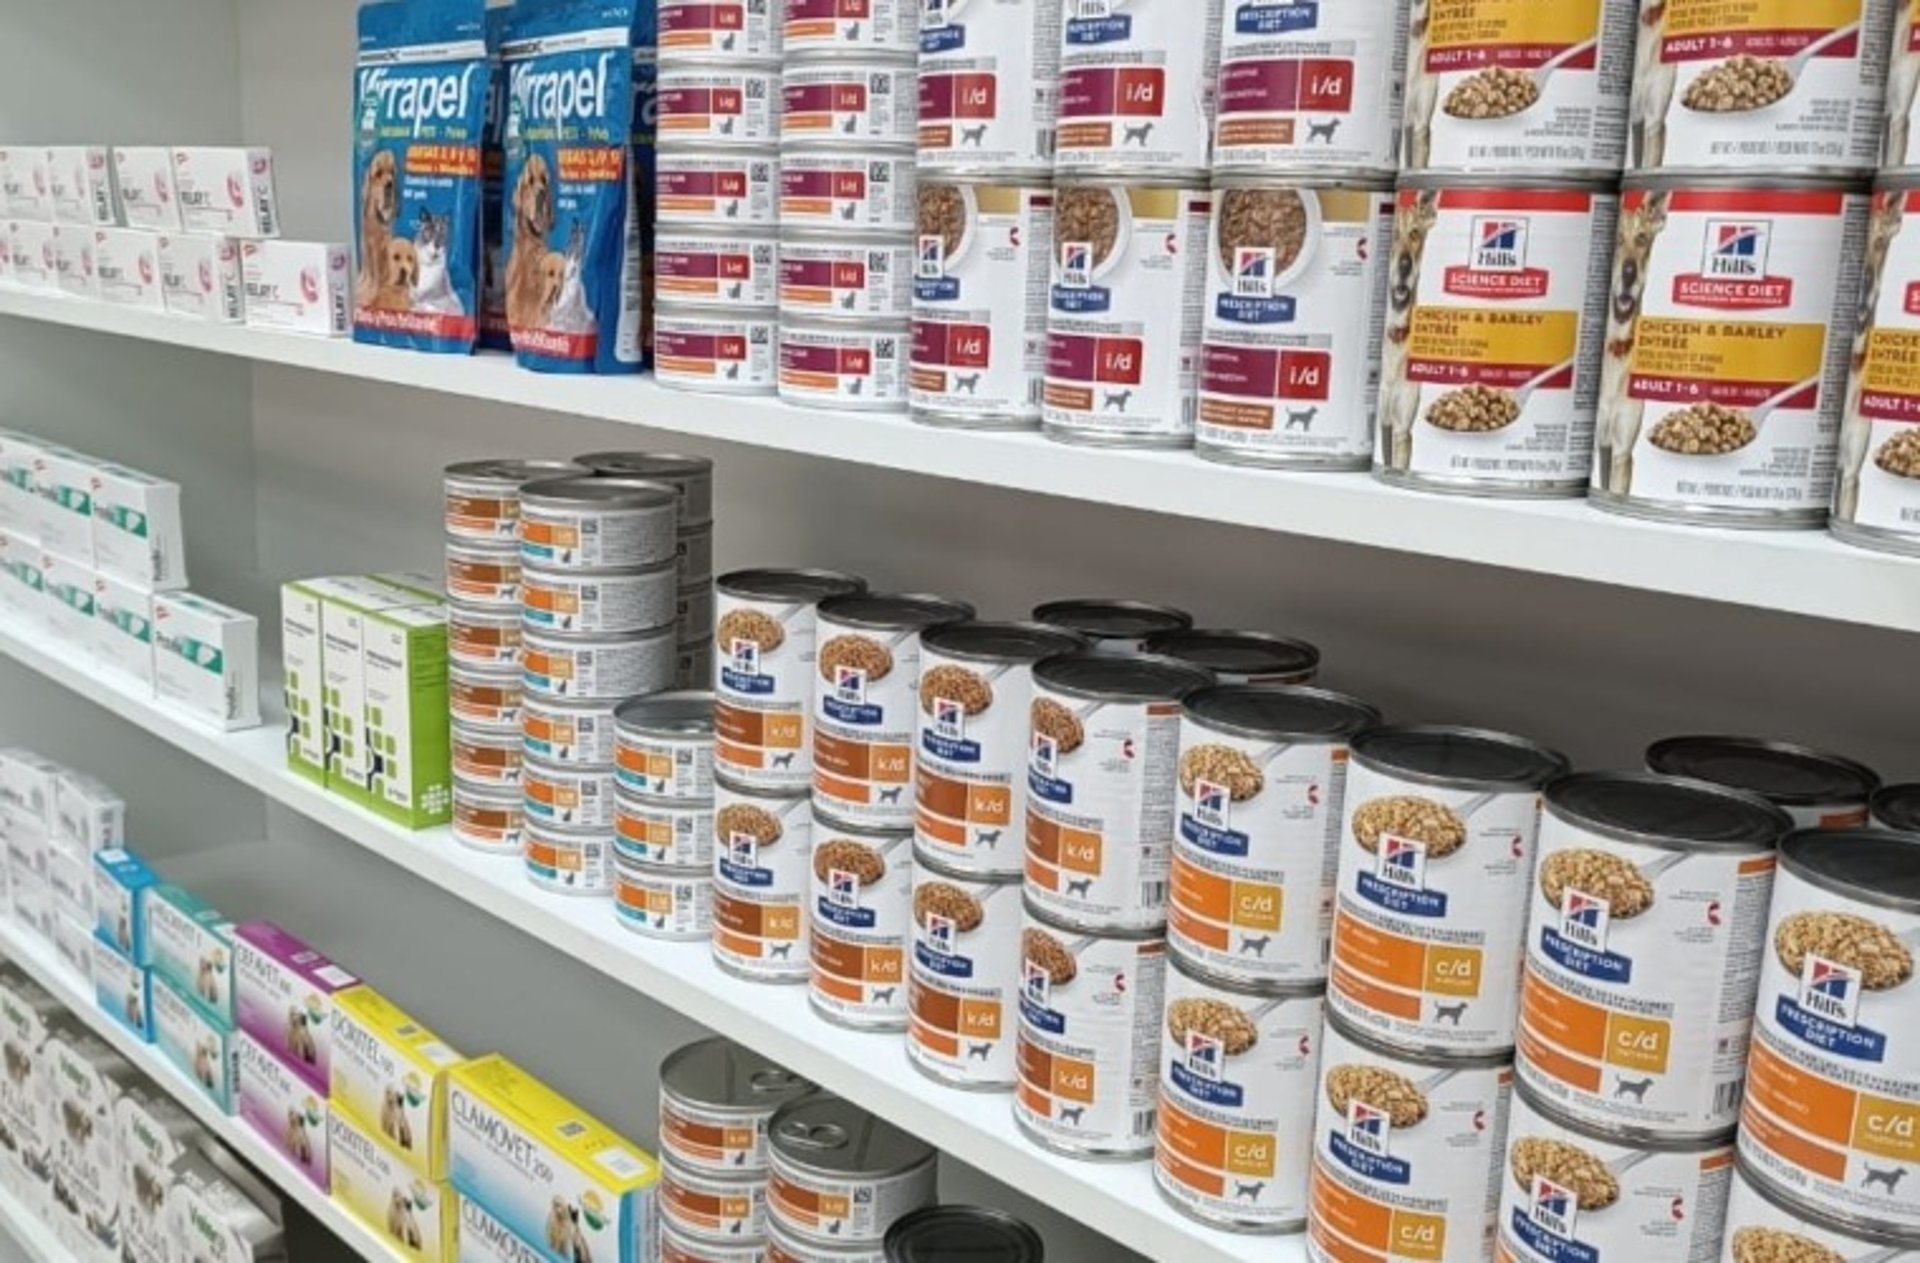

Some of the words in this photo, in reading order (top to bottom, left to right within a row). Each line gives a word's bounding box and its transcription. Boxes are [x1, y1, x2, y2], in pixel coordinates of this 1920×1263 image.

[1665, 37, 1705, 53] ADULT
[1709, 36, 1733, 49] 1-6
[1429, 49, 1461, 64] ADULT
[1126, 83, 1154, 102] i/d
[1311, 76, 1342, 96] i/d
[962, 87, 986, 105] i/d
[1451, 273, 1506, 286] SCIENCE
[1509, 275, 1541, 287] DIET
[1680, 281, 1744, 297] SCIENCE
[1747, 283, 1784, 298] DIET
[1489, 312, 1543, 325] BARLEY
[1639, 319, 1700, 335] CHICKEN
[1722, 325, 1787, 339] BARLEY
[956, 336, 982, 356] i/d
[1873, 332, 1920, 347] CHICKE
[1105, 351, 1132, 371] i/d
[1411, 363, 1445, 375] ADULT
[1290, 365, 1320, 386] i/d
[1633, 379, 1673, 393] ADULT
[1677, 383, 1699, 395] 1-6
[974, 801, 1004, 814] k/d
[1067, 845, 1095, 860] k/d
[1240, 894, 1273, 912] c/d
[1436, 959, 1472, 977] c/d
[967, 1014, 995, 1028] k/d
[1779, 1003, 1876, 1050] PRESCRIPTION
[1617, 1030, 1659, 1050] c/d
[1058, 1073, 1088, 1089] k/d
[451, 1089, 534, 1167] CLAMOVET
[1868, 1114, 1914, 1138] c/d
[1234, 1142, 1267, 1160] c/d
[1401, 1225, 1435, 1242] c/d
